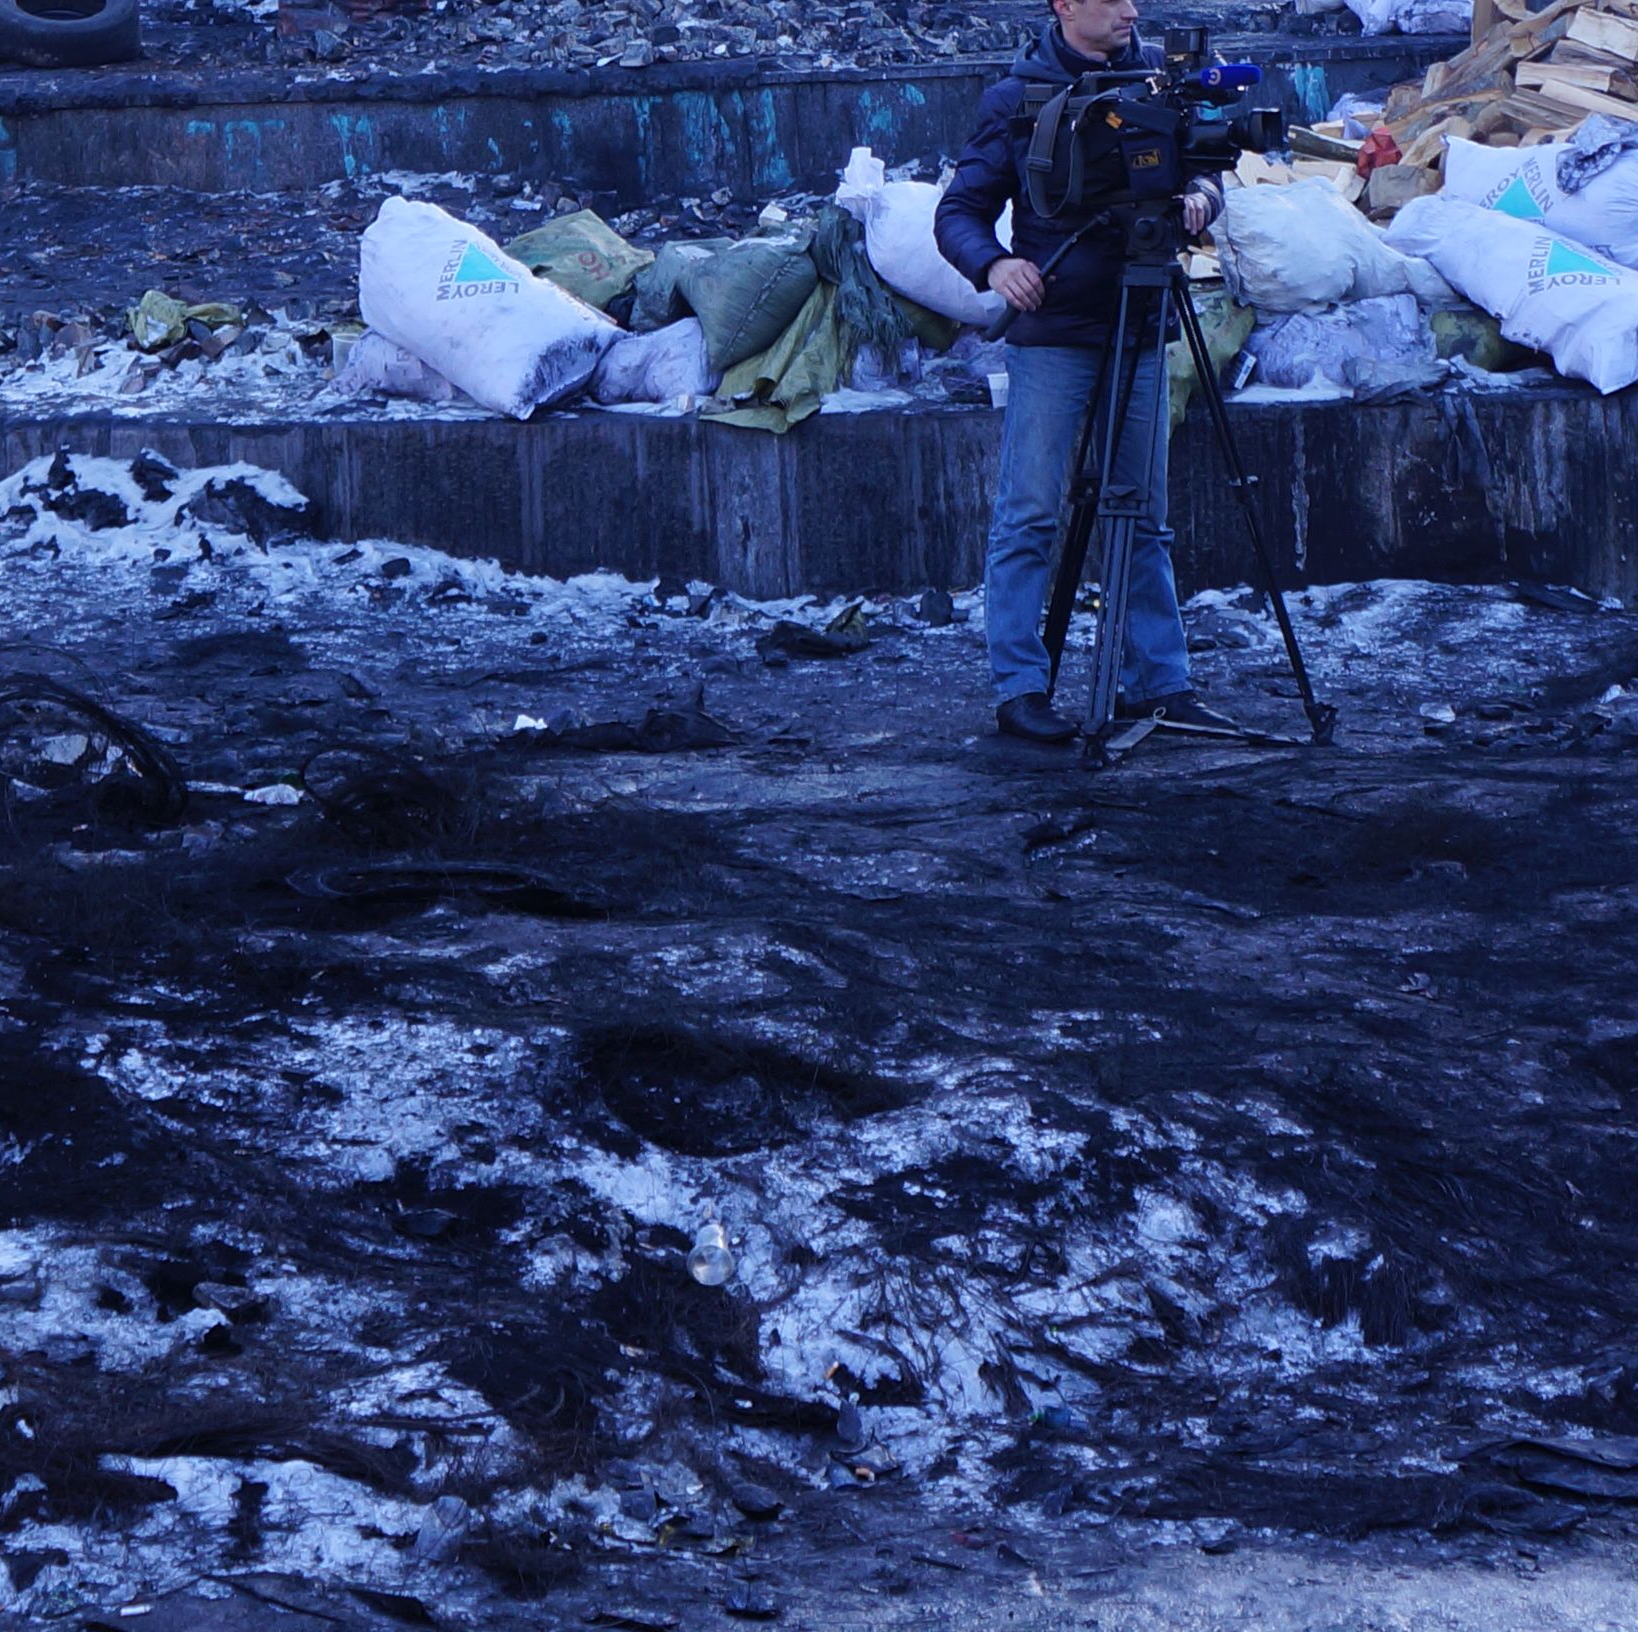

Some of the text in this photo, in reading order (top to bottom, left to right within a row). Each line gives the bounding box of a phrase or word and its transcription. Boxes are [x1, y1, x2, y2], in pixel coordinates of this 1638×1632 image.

[1477, 156, 1555, 214] EROY MERLIN
[435, 239, 468, 302] MERLIN
[450, 281, 520, 300] LEROY
[1527, 235, 1552, 297] MERLIN
[1546, 272, 1622, 292] LEROY
